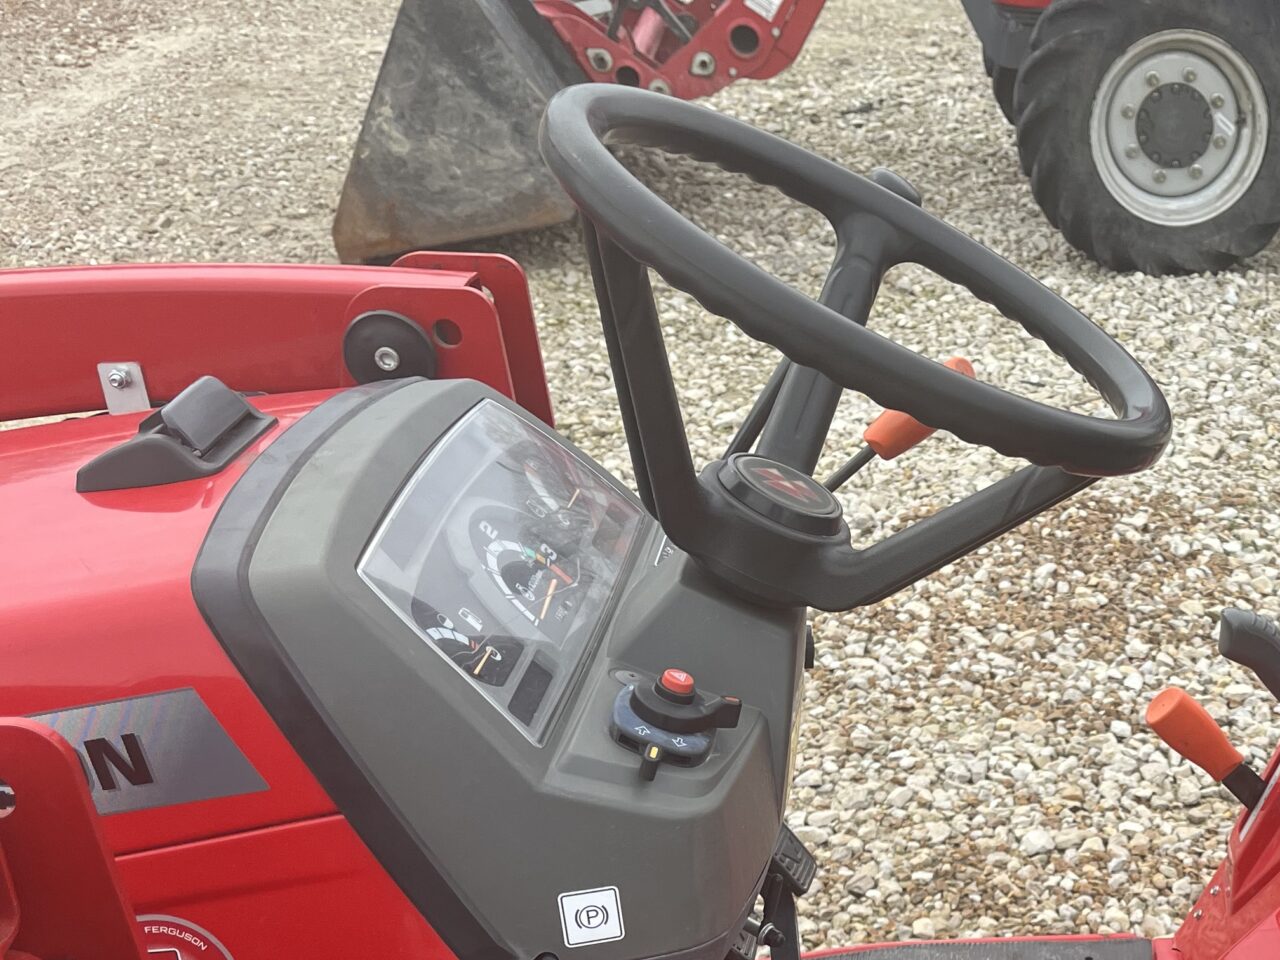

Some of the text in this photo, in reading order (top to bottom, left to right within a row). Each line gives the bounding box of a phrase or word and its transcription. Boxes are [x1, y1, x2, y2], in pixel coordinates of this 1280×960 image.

[479, 520, 499, 540] 2
[540, 543, 558, 561] 3
[73, 732, 154, 791] N
[144, 925, 208, 951] FERGUSON
